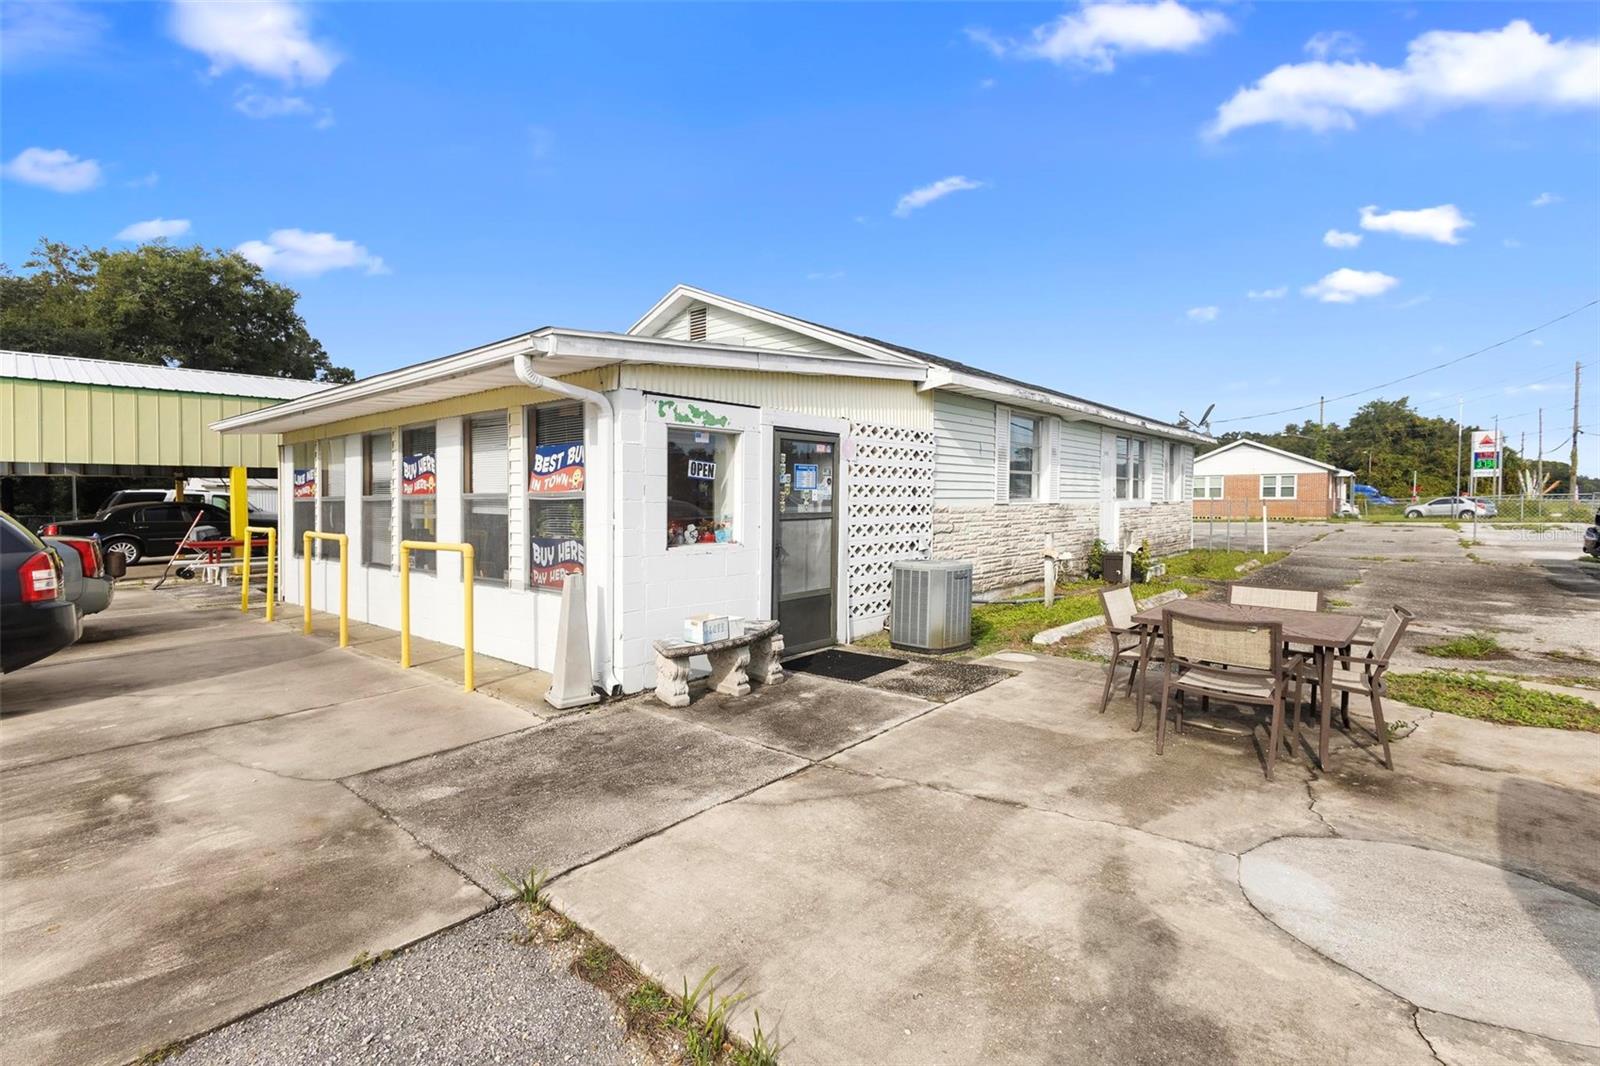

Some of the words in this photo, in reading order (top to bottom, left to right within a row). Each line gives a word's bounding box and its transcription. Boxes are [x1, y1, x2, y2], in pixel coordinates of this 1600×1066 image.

[403, 461, 417, 480] BUY
[417, 454, 435, 475] HERE
[533, 452, 564, 473] BEST
[690, 461, 715, 478] OPEN
[531, 479, 541, 491] IN
[543, 473, 568, 490] TOWN
[532, 542, 555, 567] BUY
[557, 541, 585, 564] HERE
[532, 568, 548, 585] PAY
[549, 567, 567, 583] HER
